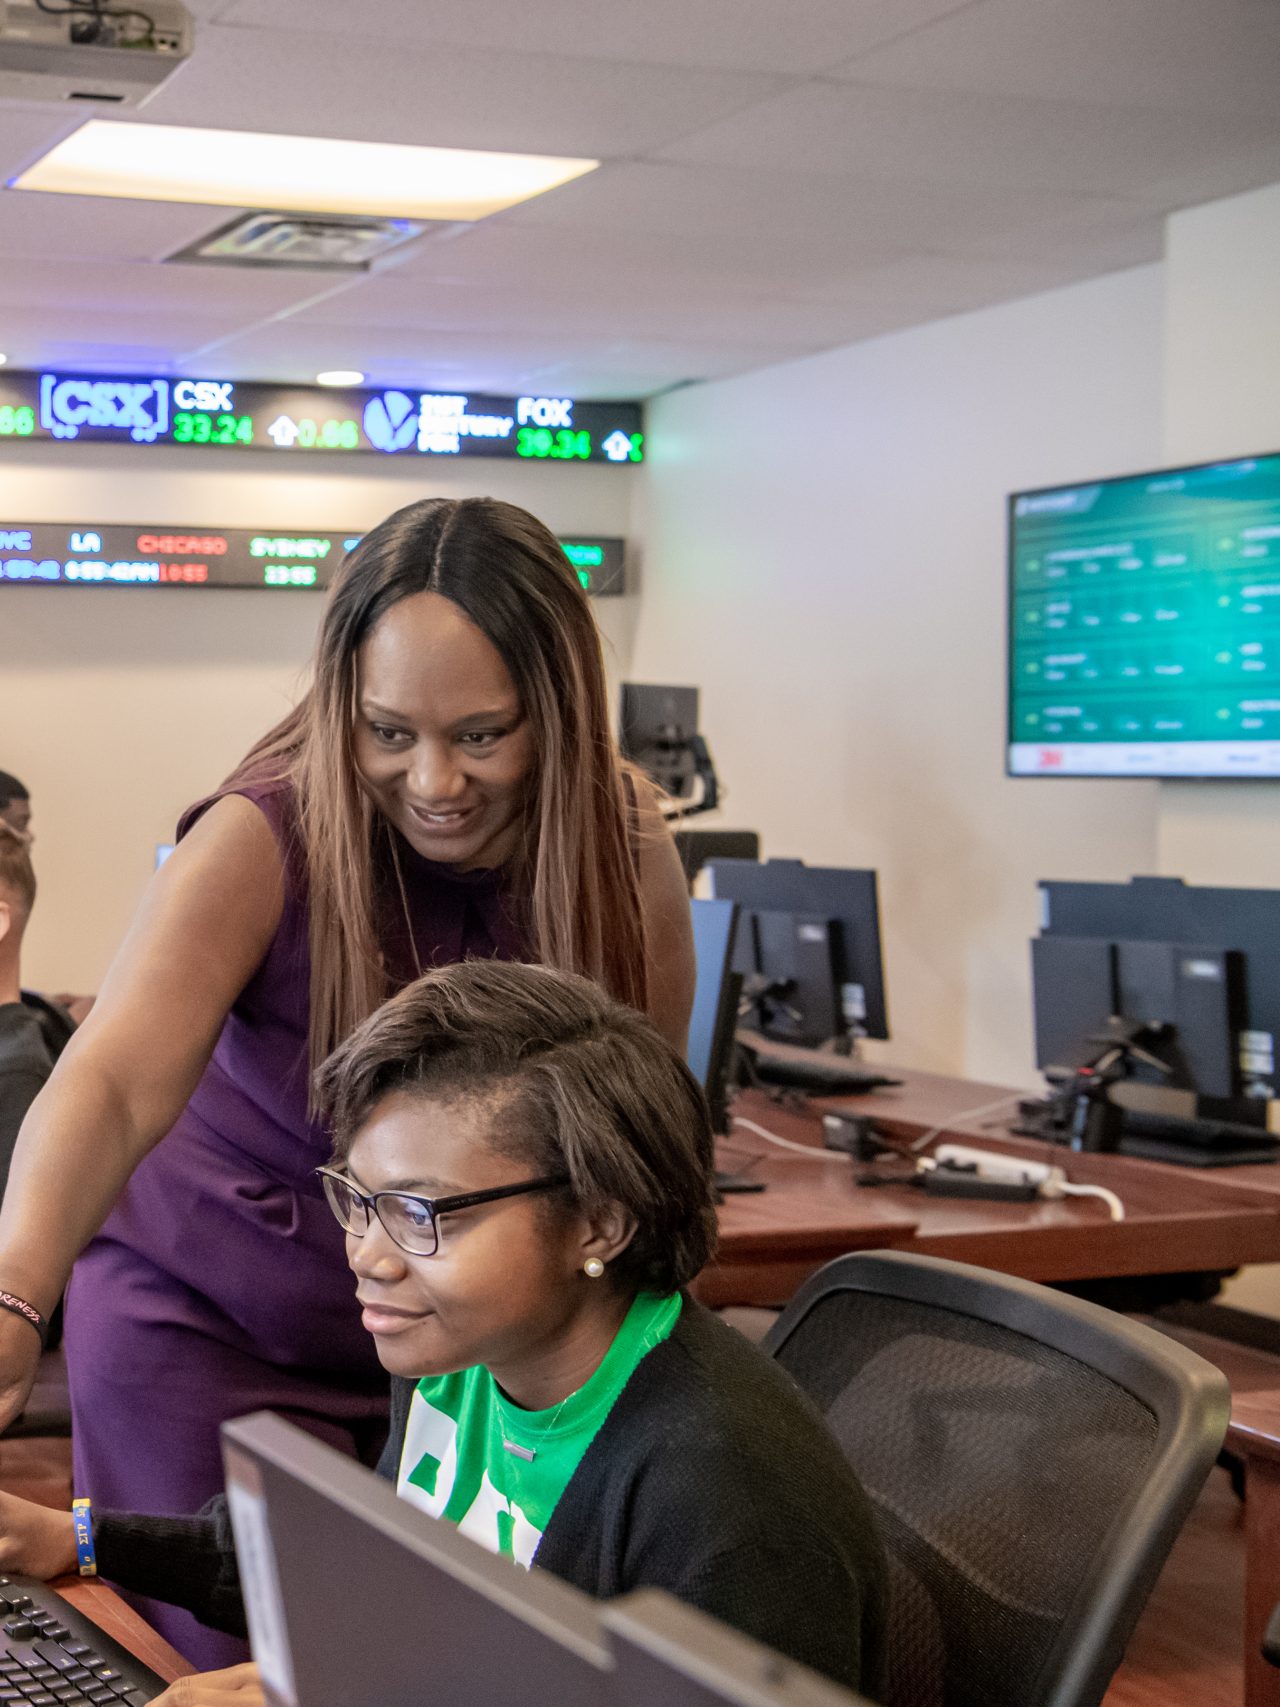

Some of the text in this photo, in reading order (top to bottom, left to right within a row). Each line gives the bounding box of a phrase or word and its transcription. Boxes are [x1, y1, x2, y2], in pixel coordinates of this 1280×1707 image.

[52, 379, 155, 428] CSX
[174, 380, 233, 411] CSX
[518, 397, 573, 427] FOX
[173, 413, 253, 444] 33.24
